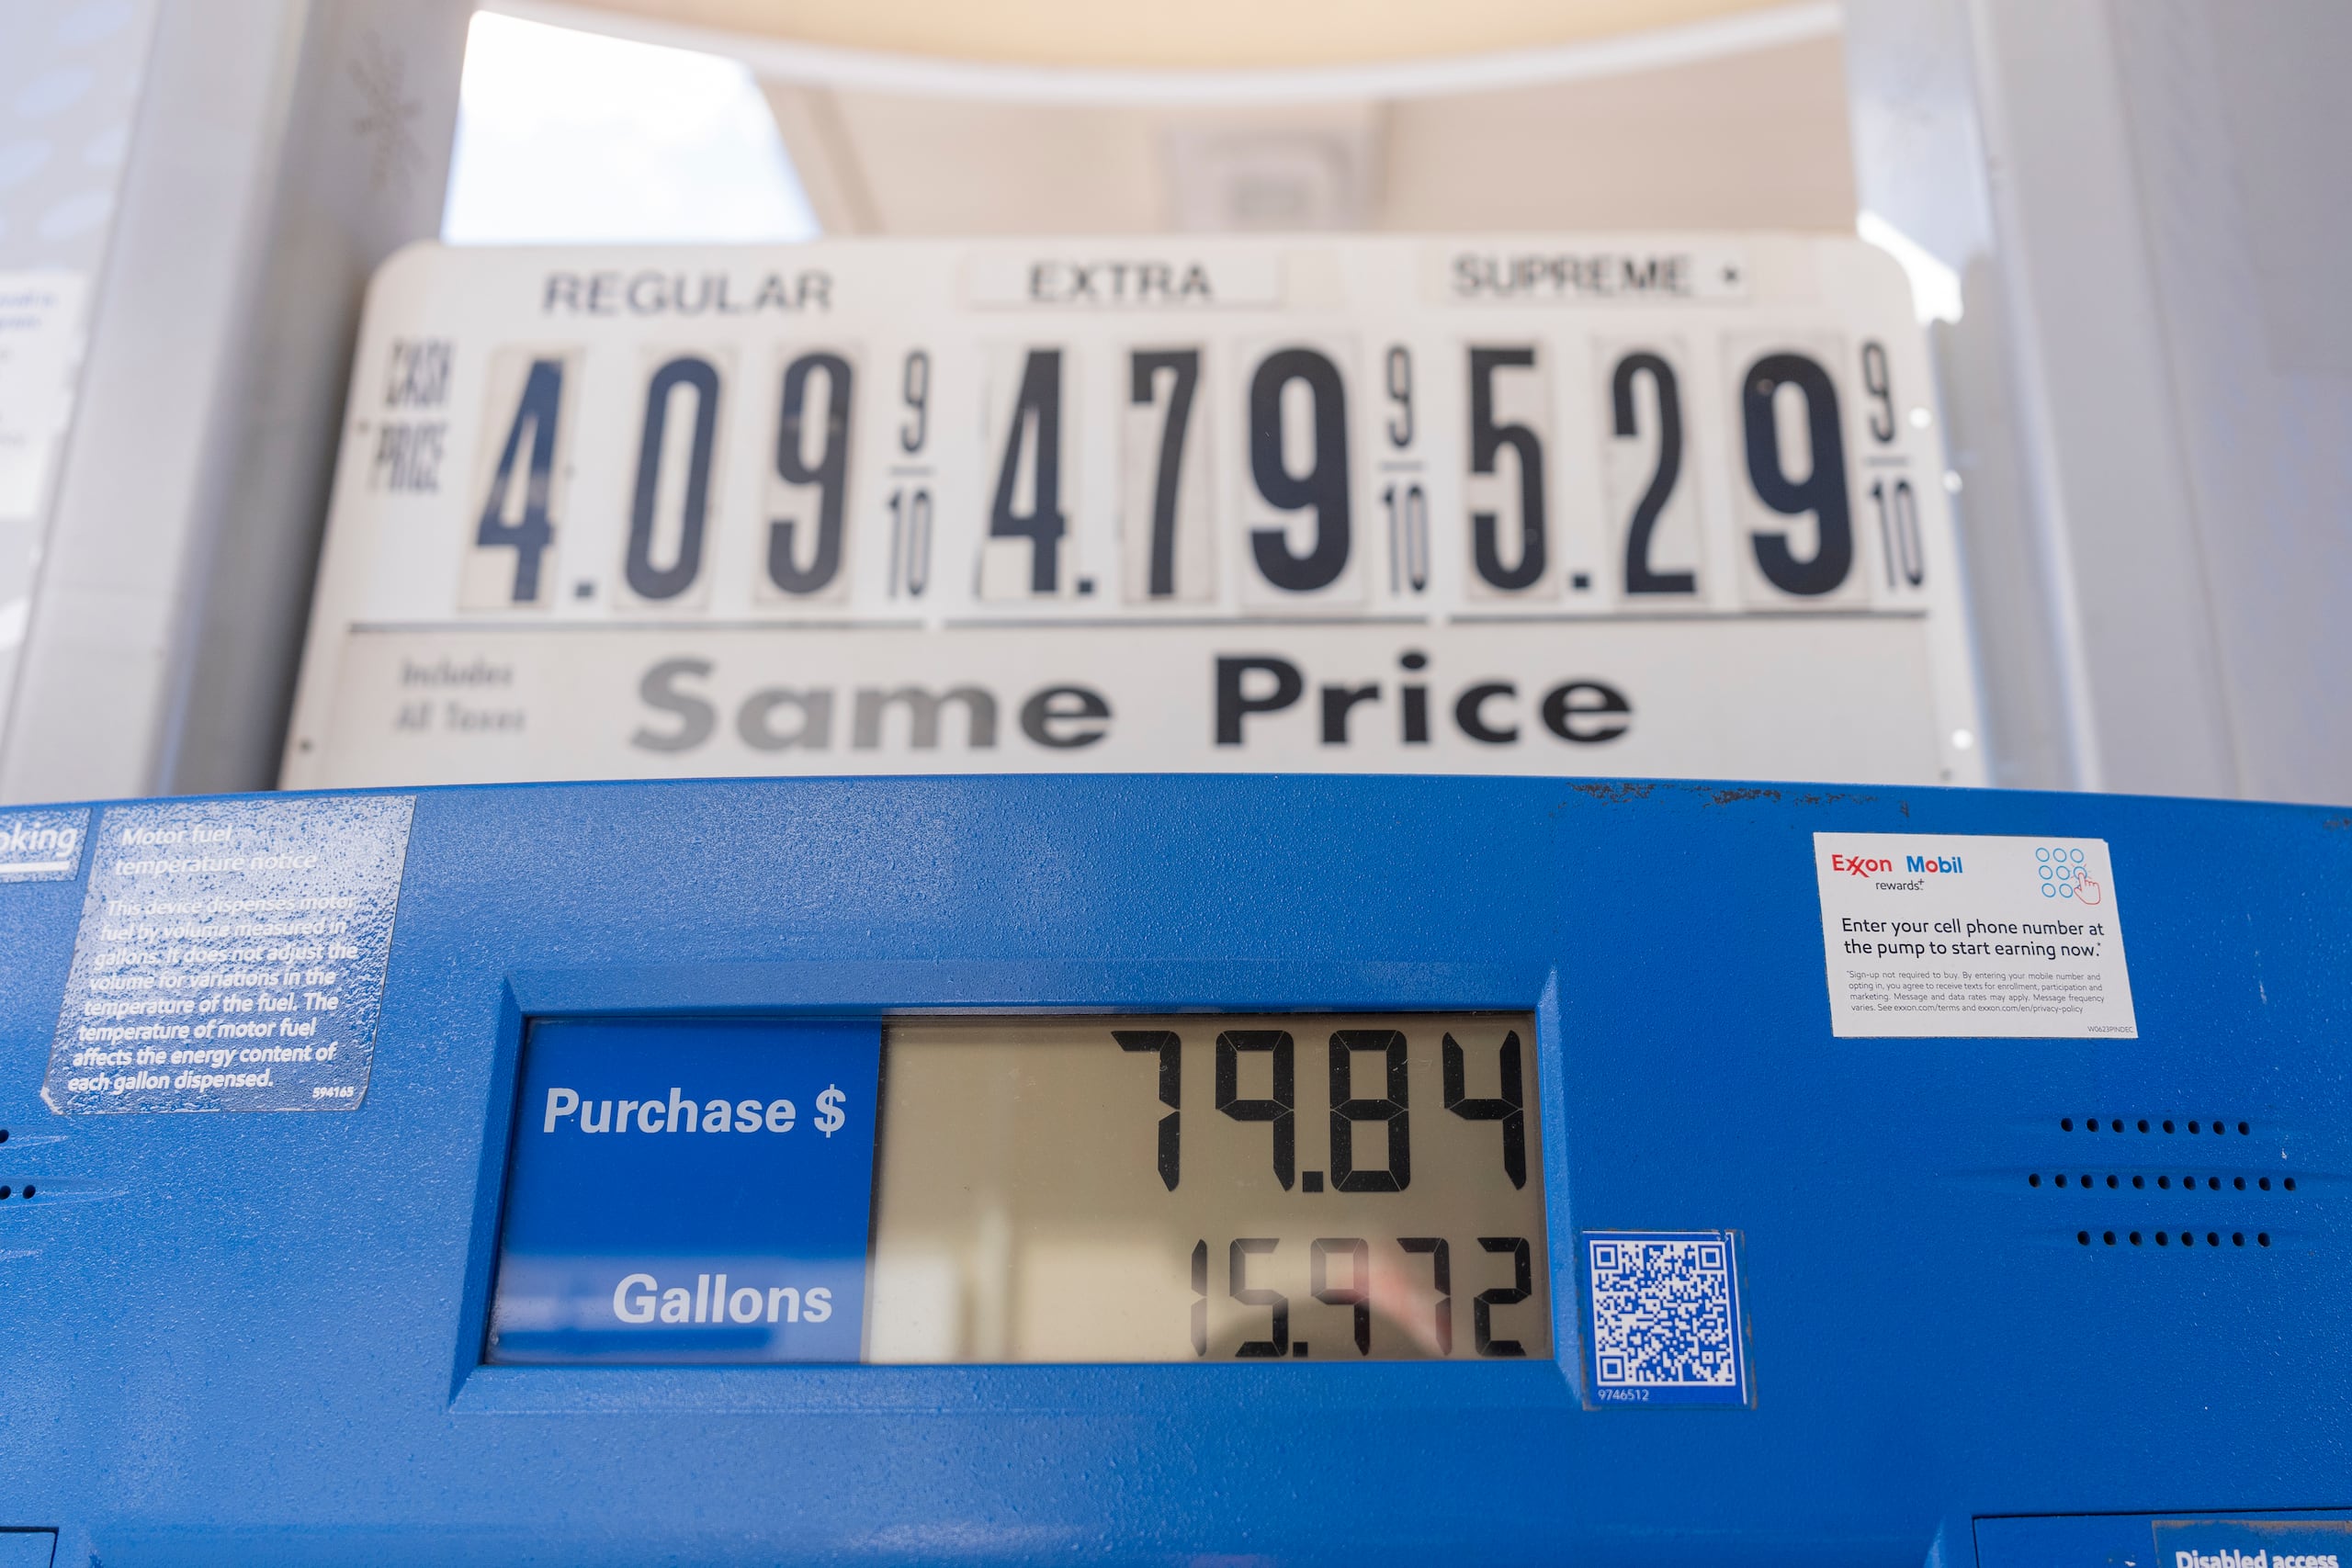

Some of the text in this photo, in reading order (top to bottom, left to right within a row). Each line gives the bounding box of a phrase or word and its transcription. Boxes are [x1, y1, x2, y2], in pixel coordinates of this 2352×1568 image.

[1029, 262, 1213, 302] EXTRA
[1453, 254, 1692, 297] SUPREME
[543, 270, 833, 316] REGULAR
[901, 350, 930, 453] 9
[1386, 345, 1413, 447] 9
[1862, 340, 1894, 444] 9
[476, 353, 853, 602] 4.09
[989, 346, 1351, 596] 4.79
[1467, 346, 1853, 596] 5.29
[888, 488, 932, 600] 10
[1382, 483, 1428, 596] 10
[1869, 479, 1924, 592] 10
[630, 650, 1632, 754] Same Price
[122, 823, 232, 845] Motor fuel
[115, 852, 318, 877] temperature notice
[1831, 854, 1963, 877] Exxon Mobil
[107, 896, 356, 916] This device dispenses motor
[100, 919, 347, 943] fuel by volume measured in
[1841, 918, 2104, 937] Enter your cell phone number at
[96, 943, 358, 970] gallons. It does not adjust the
[1844, 939, 1872, 953] the
[1877, 943, 1925, 958] pump
[1929, 942, 1947, 954] to
[1951, 942, 1991, 954] start
[1995, 941, 2056, 960] earning
[90, 969, 337, 991] volume for variations in the
[1849, 982, 1873, 991] opting
[1984, 982, 1996, 990] for
[1898, 971, 1930, 980] required
[1944, 972, 1960, 980] buy.
[1962, 971, 1972, 980] By
[1974, 972, 2006, 981] entering
[2028, 972, 2053, 980] mobile
[85, 992, 339, 1020] temperature of the fuel. The
[1849, 993, 1891, 1002] marketing.
[1894, 993, 1928, 1002] Message
[2008, 994, 2030, 1002] apply.
[2033, 994, 2065, 1003] Message
[2068, 994, 2104, 1003] frequency
[1851, 1003, 1875, 1011] varies.
[1877, 1003, 1893, 1011] See
[1894, 1003, 1960, 1011] exxon.com/terms
[1978, 1004, 2083, 1014] exxon.com/en/privacy-policy
[79, 1018, 317, 1044] temperature of motor fuel
[73, 1042, 339, 1068] affects the energy content of
[68, 1069, 274, 1095] each gallon dispensed.
[312, 1087, 354, 1099] 594165
[544, 1083, 846, 1139] Purchase $
[1111, 1030, 1527, 1192] 79.84
[613, 1272, 833, 1325] Gallons
[1191, 1236, 1532, 1358] 15.972
[1597, 1388, 1650, 1402] 9746512
[2175, 1549, 2340, 1568] Disabled access
